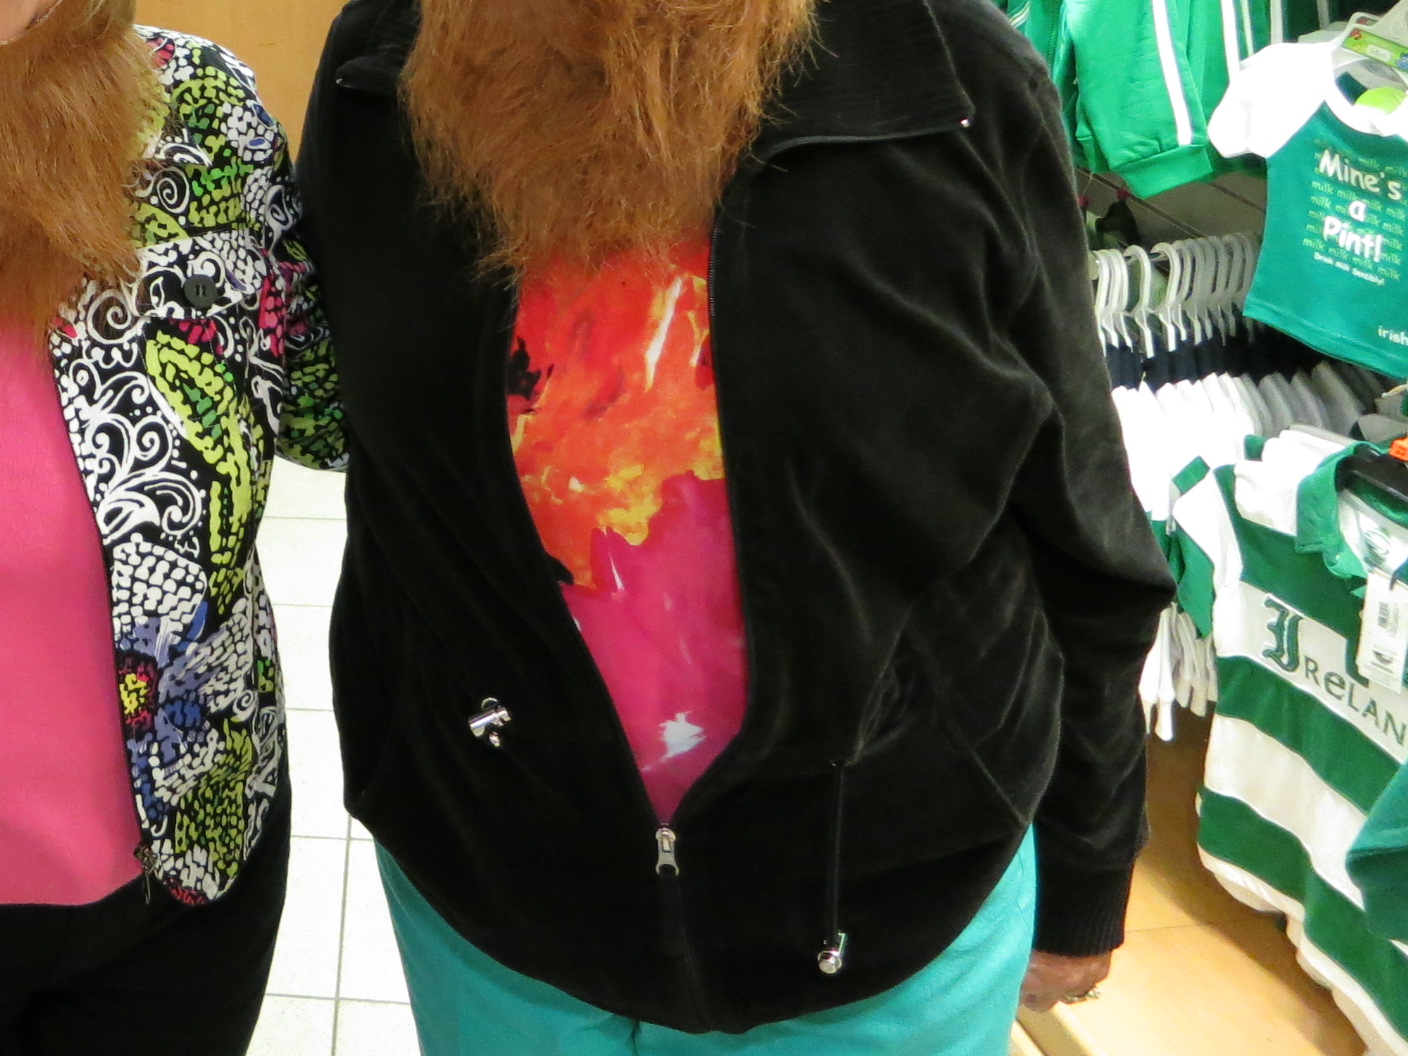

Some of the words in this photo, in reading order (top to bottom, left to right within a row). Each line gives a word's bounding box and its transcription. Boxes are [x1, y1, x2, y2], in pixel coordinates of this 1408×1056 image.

[1319, 149, 1402, 200] Mine's
[1349, 200, 1366, 222] a
[1323, 216, 1383, 262] Pint!
